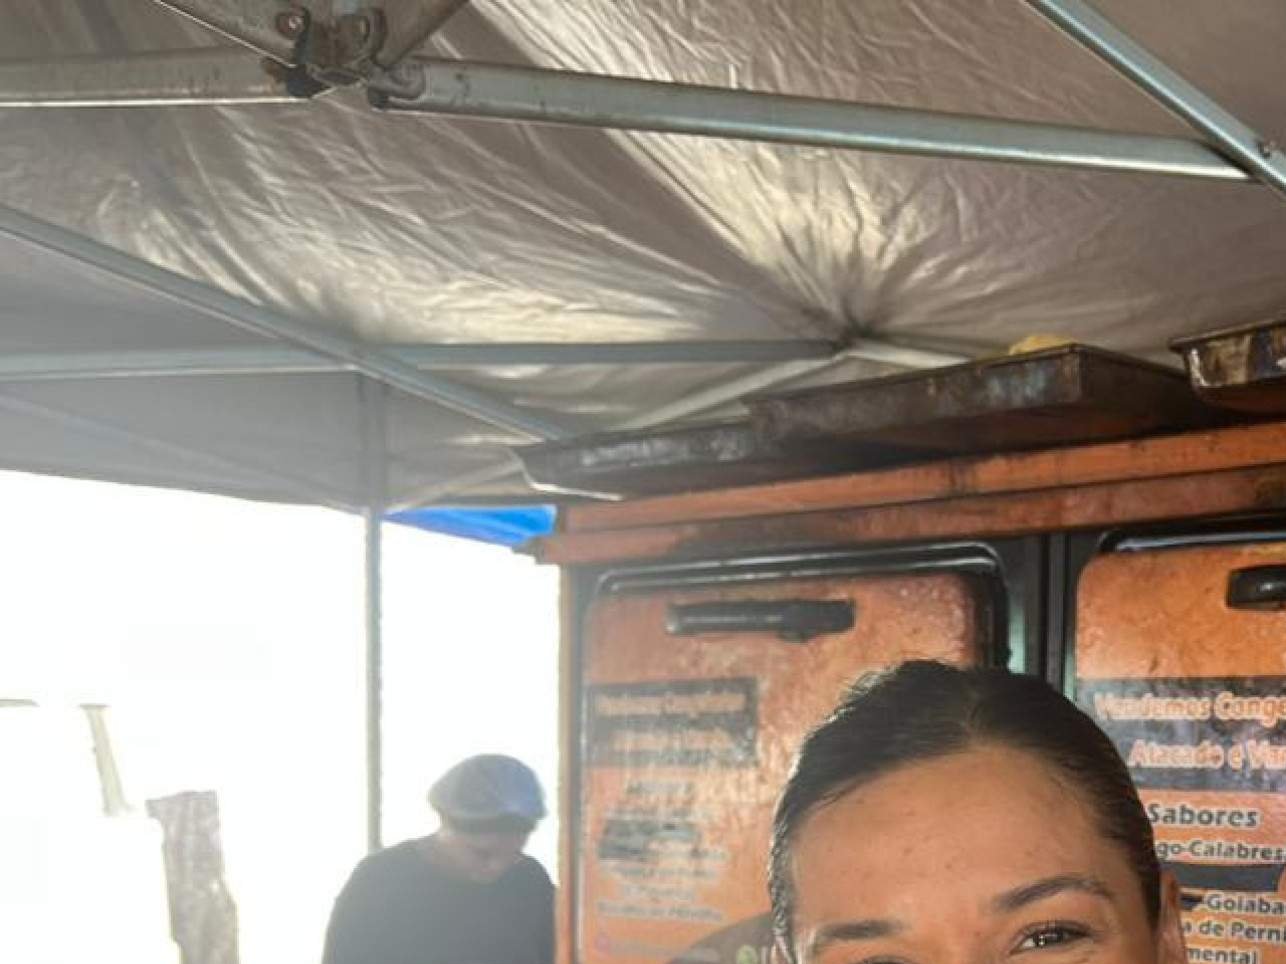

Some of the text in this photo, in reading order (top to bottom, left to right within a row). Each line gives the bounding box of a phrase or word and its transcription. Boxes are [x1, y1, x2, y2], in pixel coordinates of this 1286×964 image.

[1127, 738, 1224, 768] Atacado
[1228, 744, 1243, 769] e
[1148, 803, 1259, 828] Sabores
[1199, 919, 1225, 937] de
